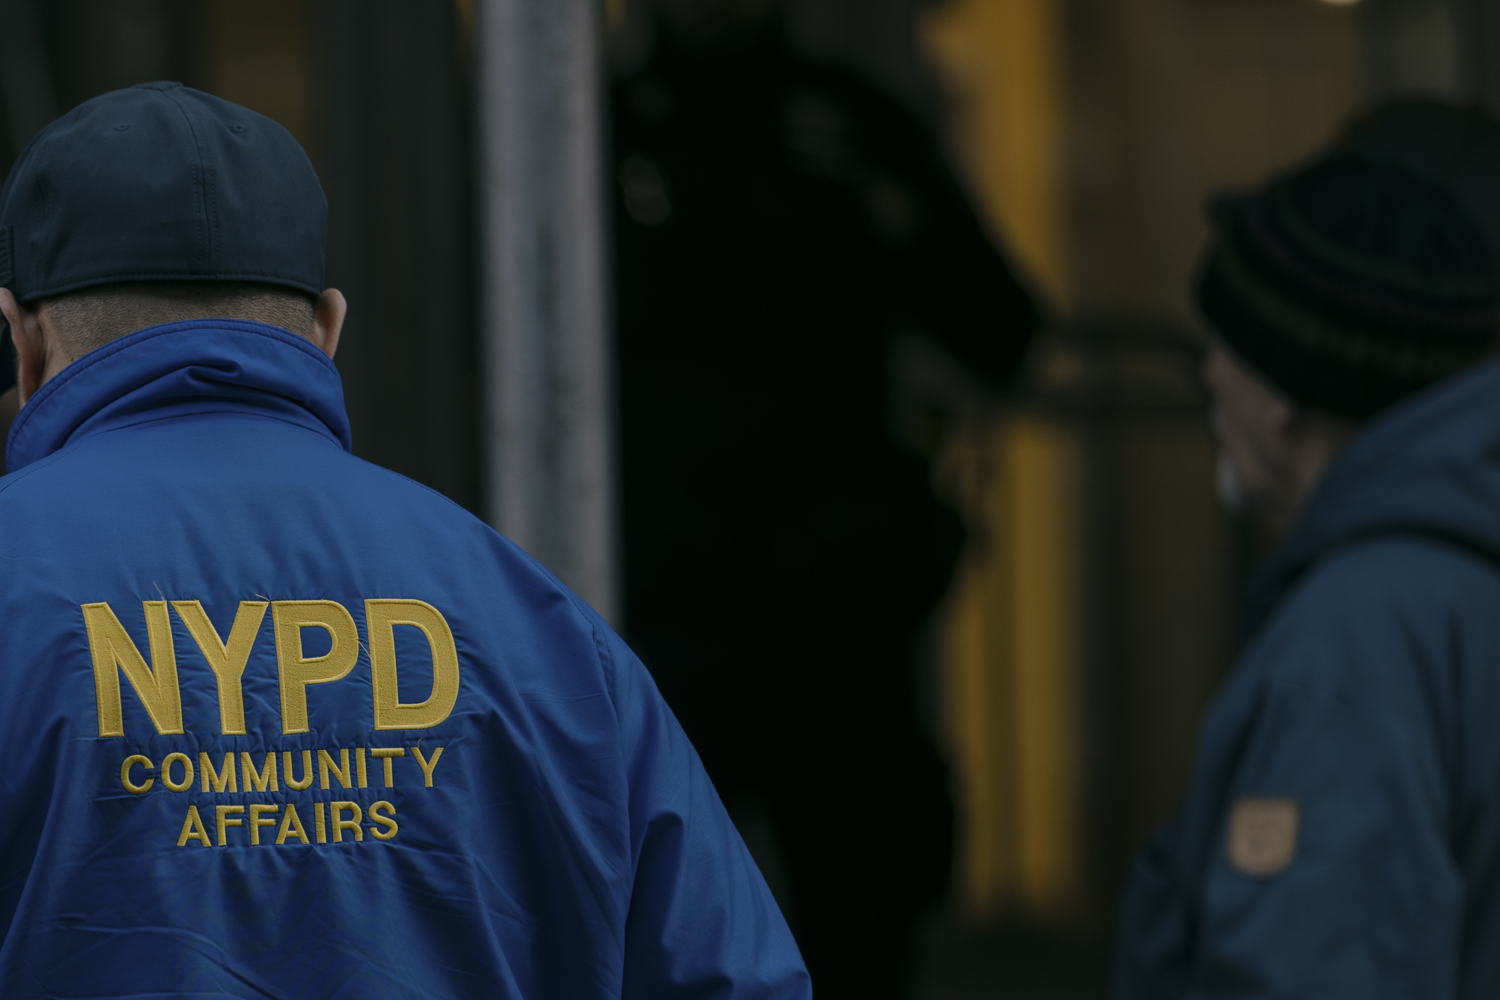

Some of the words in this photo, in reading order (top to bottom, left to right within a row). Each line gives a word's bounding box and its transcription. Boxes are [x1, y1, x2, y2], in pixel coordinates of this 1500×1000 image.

[80, 598, 460, 738] NYPD
[120, 746, 444, 795] COMMUNITY
[177, 800, 399, 847] AFFAIRS
